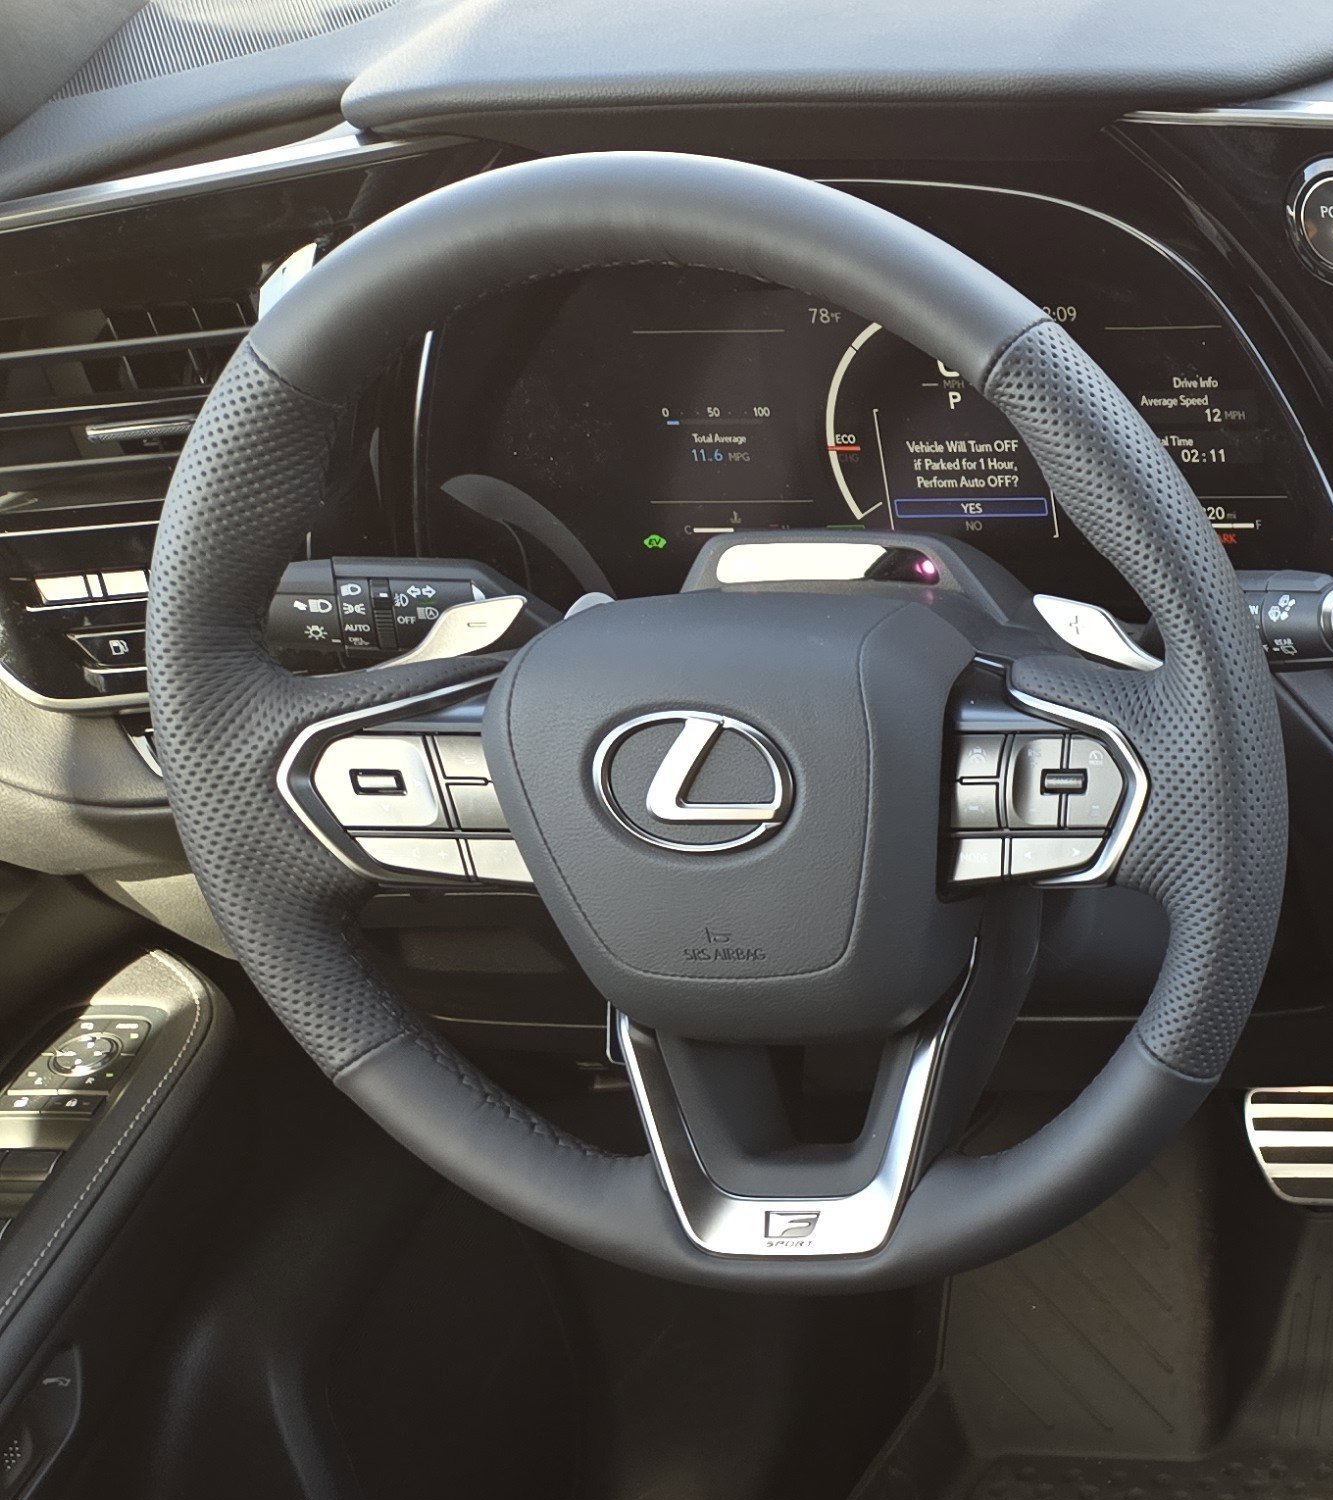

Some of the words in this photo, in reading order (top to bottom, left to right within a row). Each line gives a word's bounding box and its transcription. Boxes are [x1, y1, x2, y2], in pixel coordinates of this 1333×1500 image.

[943, 380, 964, 389] MPH
[1173, 377, 1197, 388] Drive
[1200, 377, 1218, 388] Info
[949, 392, 961, 410] P
[1140, 396, 1178, 408] Average
[1179, 395, 1208, 407] Speed
[662, 408, 669, 417] 0
[707, 407, 720, 417] 50
[753, 407, 770, 417] 100
[1205, 409, 1222, 422] 12
[1225, 411, 1245, 420] MPH
[692, 433, 712, 444] Total
[714, 434, 746, 446] Average
[836, 434, 856, 444] ECO
[1170, 436, 1193, 446] Time
[906, 441, 944, 453] Vehicle
[947, 441, 967, 452] Will
[969, 441, 992, 452] Turn
[994, 440, 1018, 452] OFF
[692, 449, 723, 462] 11.6
[729, 452, 750, 461] MPG
[1181, 449, 1226, 463] 02:11
[914, 459, 921, 470] if
[924, 458, 960, 471] Parked
[962, 458, 978, 470] for
[979, 459, 985, 469] 1
[990, 459, 1018, 471] Hour,
[917, 475, 957, 488] Perform
[960, 475, 985, 488] Auto
[988, 475, 1019, 488] OFF?
[961, 503, 983, 514] YES
[1202, 506, 1225, 520] 20
[684, 525, 692, 535] C
[966, 521, 983, 531] NO
[1255, 519, 1261, 530] F
[397, 616, 416, 624] OFF
[344, 624, 370, 632] AUTO
[684, 948, 711, 961] SRS
[714, 947, 766, 961] AIRBAG
